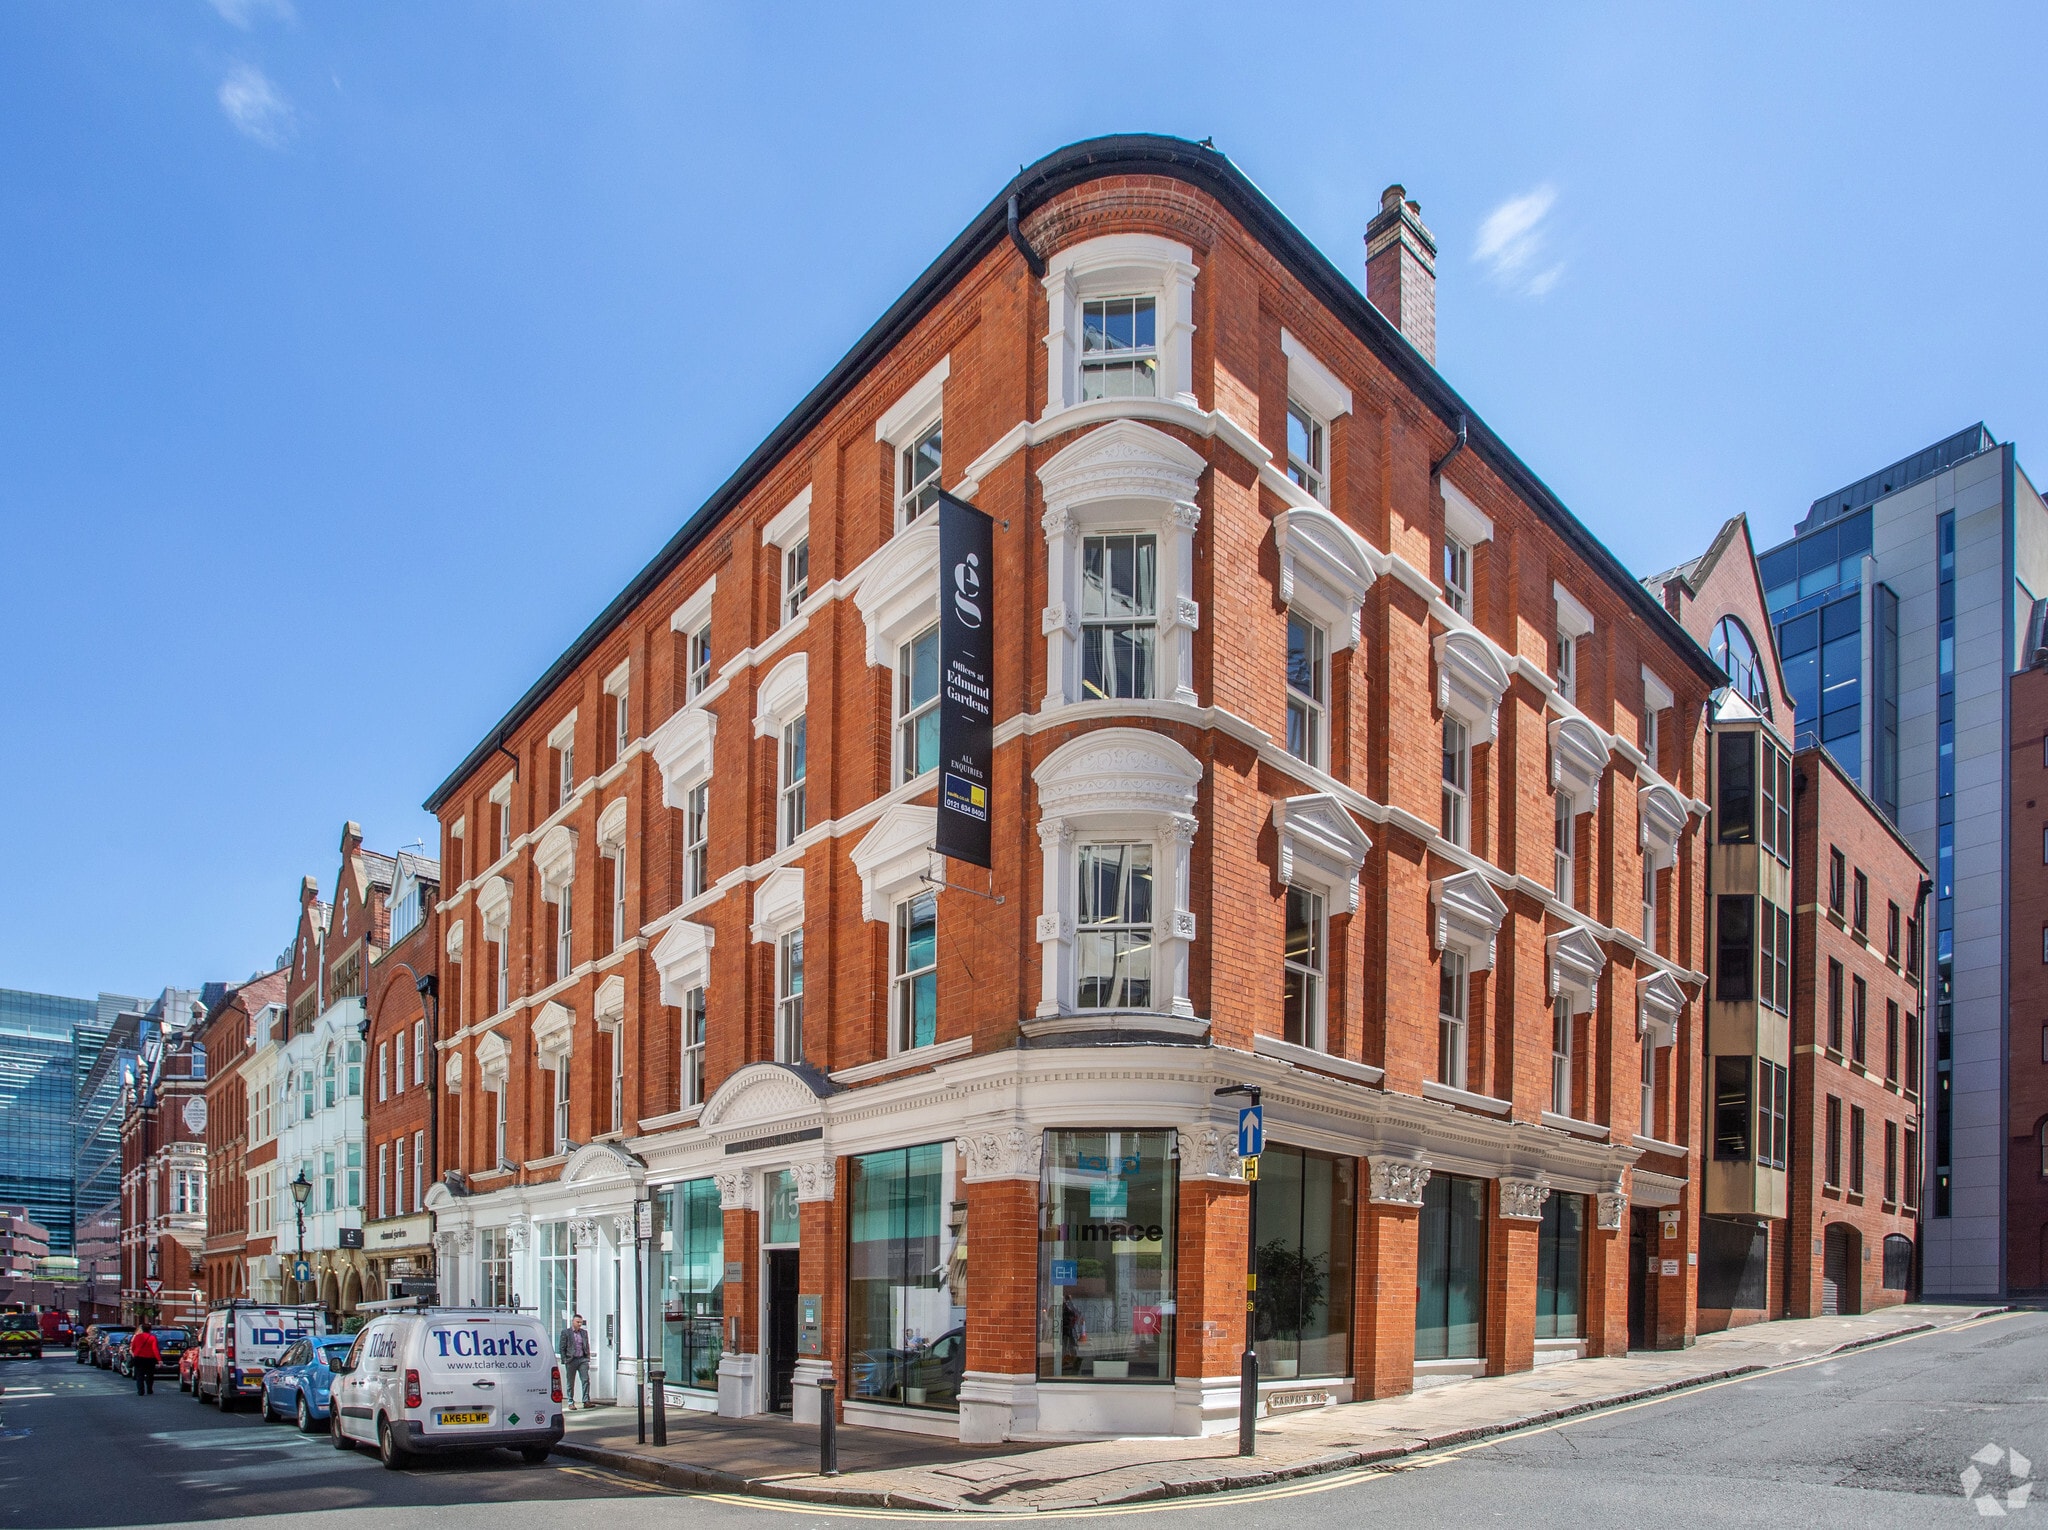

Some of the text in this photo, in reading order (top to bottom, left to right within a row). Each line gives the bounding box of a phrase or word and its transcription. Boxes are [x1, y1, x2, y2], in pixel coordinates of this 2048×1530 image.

[952, 660, 984, 683] Offices at
[947, 669, 990, 700] Edmund
[947, 685, 989, 715] Gardens
[951, 759, 983, 779] ENQUIRIES
[961, 754, 974, 766] ALL
[946, 798, 960, 809] 0121
[742, 1132, 801, 1151] ENTERPRISE HOUSE
[1244, 1160, 1256, 1180] H
[771, 1191, 800, 1220] 115
[1081, 1224, 1163, 1242] mace
[252, 1328, 307, 1345] IDS
[369, 1332, 396, 1358] TClarke
[432, 1330, 538, 1357] TClarke
[447, 1360, 531, 1370] www.tclarke.co.uk
[443, 1413, 488, 1423] AK65 LWP
